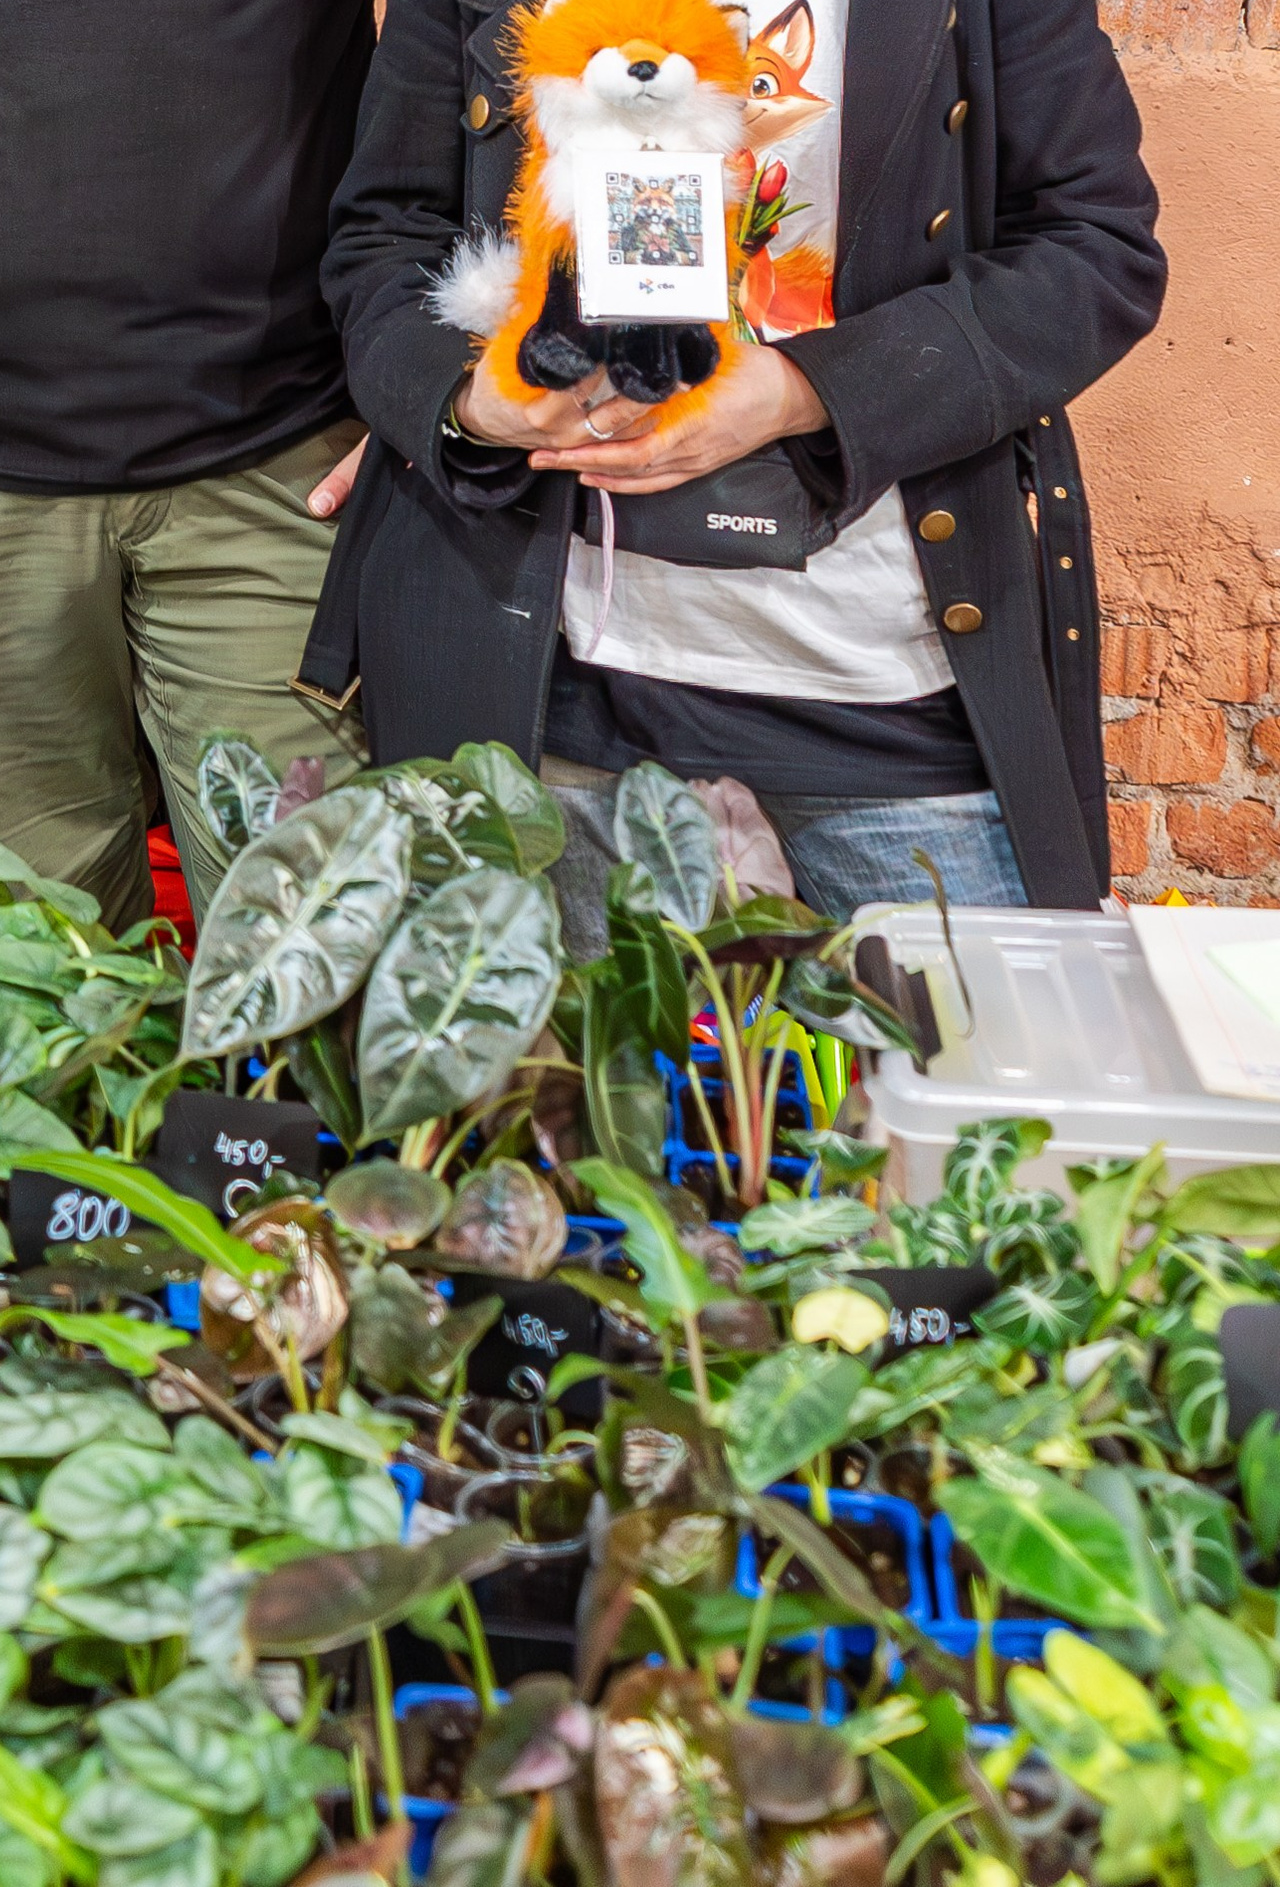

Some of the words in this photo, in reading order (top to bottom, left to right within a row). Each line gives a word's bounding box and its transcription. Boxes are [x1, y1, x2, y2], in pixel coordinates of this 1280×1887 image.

[706, 513, 778, 535] SPORTS
[214, 1131, 286, 1180] 450,-
[889, 1306, 971, 1350] 450,-
